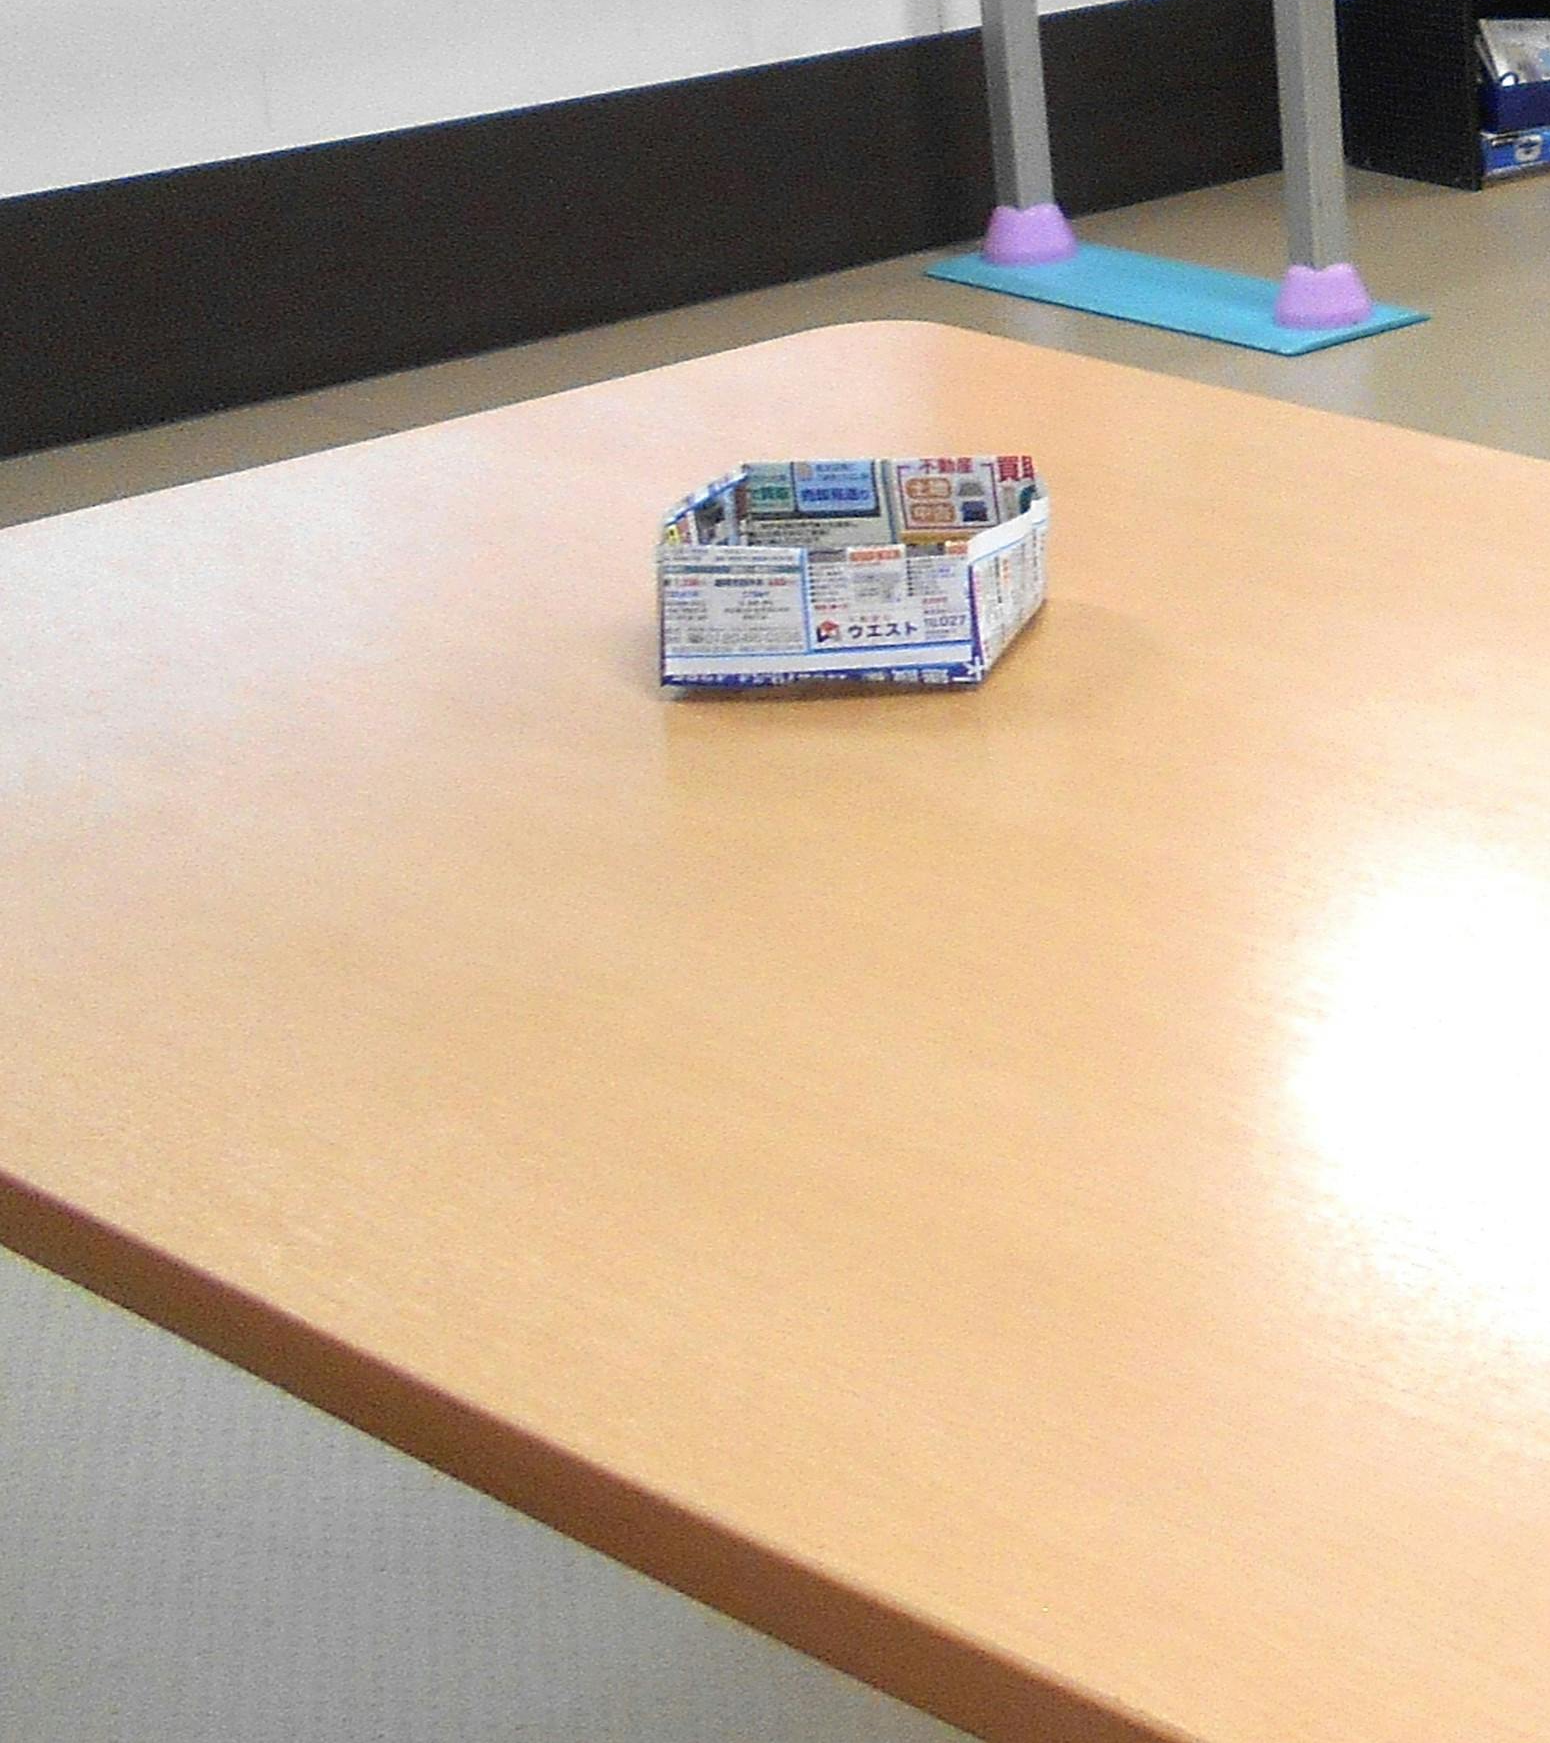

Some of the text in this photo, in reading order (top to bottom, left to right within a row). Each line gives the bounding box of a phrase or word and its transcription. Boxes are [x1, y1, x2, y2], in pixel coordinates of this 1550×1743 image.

[919, 457, 973, 474] 不動産
[847, 620, 918, 639] ウエスト
